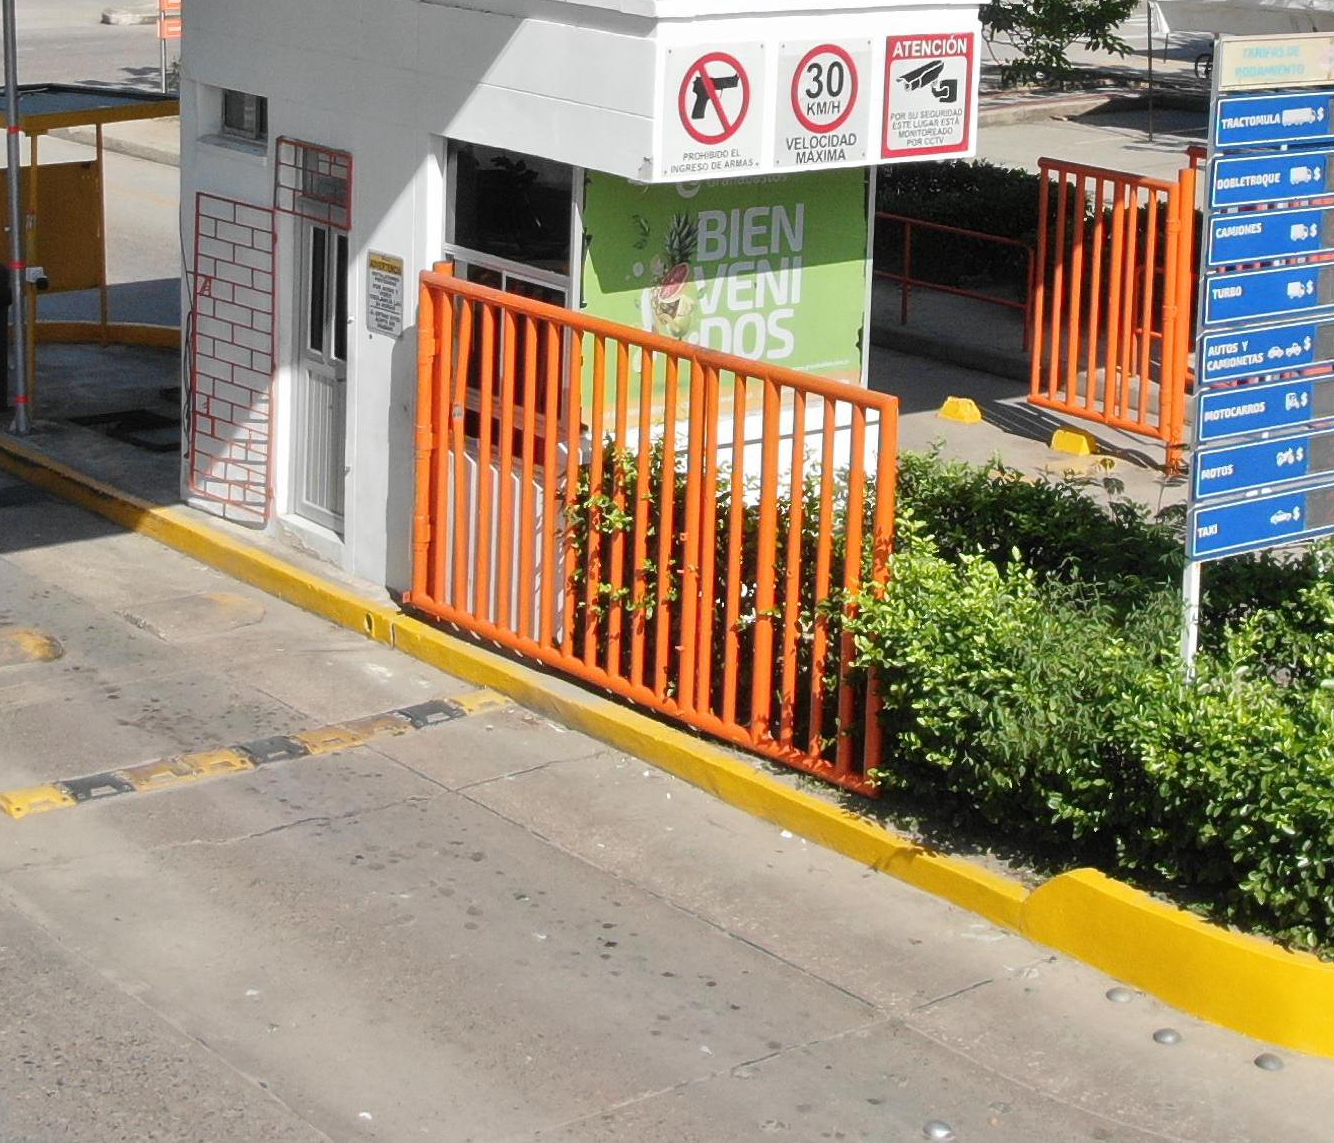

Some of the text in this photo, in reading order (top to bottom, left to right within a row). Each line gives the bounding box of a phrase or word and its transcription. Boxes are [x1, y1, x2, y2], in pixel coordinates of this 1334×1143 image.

[893, 34, 967, 57] ATENCIÓN
[805, 60, 844, 99] 30
[806, 101, 841, 116] KM/H
[891, 108, 963, 120] POR SU SEGURIDAD
[892, 121, 912, 130] ESTE
[913, 119, 939, 128] LUGAR
[1221, 114, 1281, 130] TRACTOMULA
[898, 127, 953, 138] MONITOREADO
[786, 133, 857, 150] VELOCIDAD
[907, 137, 945, 146] POR CCTV
[682, 149, 741, 161] PROHIBIDO EL
[670, 159, 754, 173] INGRESO DE ARMAS
[1217, 173, 1281, 191] DOBLETROQUE
[697, 203, 805, 262] BIEN
[1215, 223, 1262, 239] CAMIONES
[694, 256, 803, 315] VENI
[1212, 286, 1242, 300] TURBO
[698, 308, 795, 361] DOS
[1208, 343, 1238, 357] AUTOS
[1241, 340, 1249, 352] Y
[1206, 353, 1264, 372] CAMIONETAS
[1204, 402, 1266, 423] MOTOCARROS
[1201, 464, 1234, 480] MOTOS
[1197, 524, 1218, 538] TAXI
